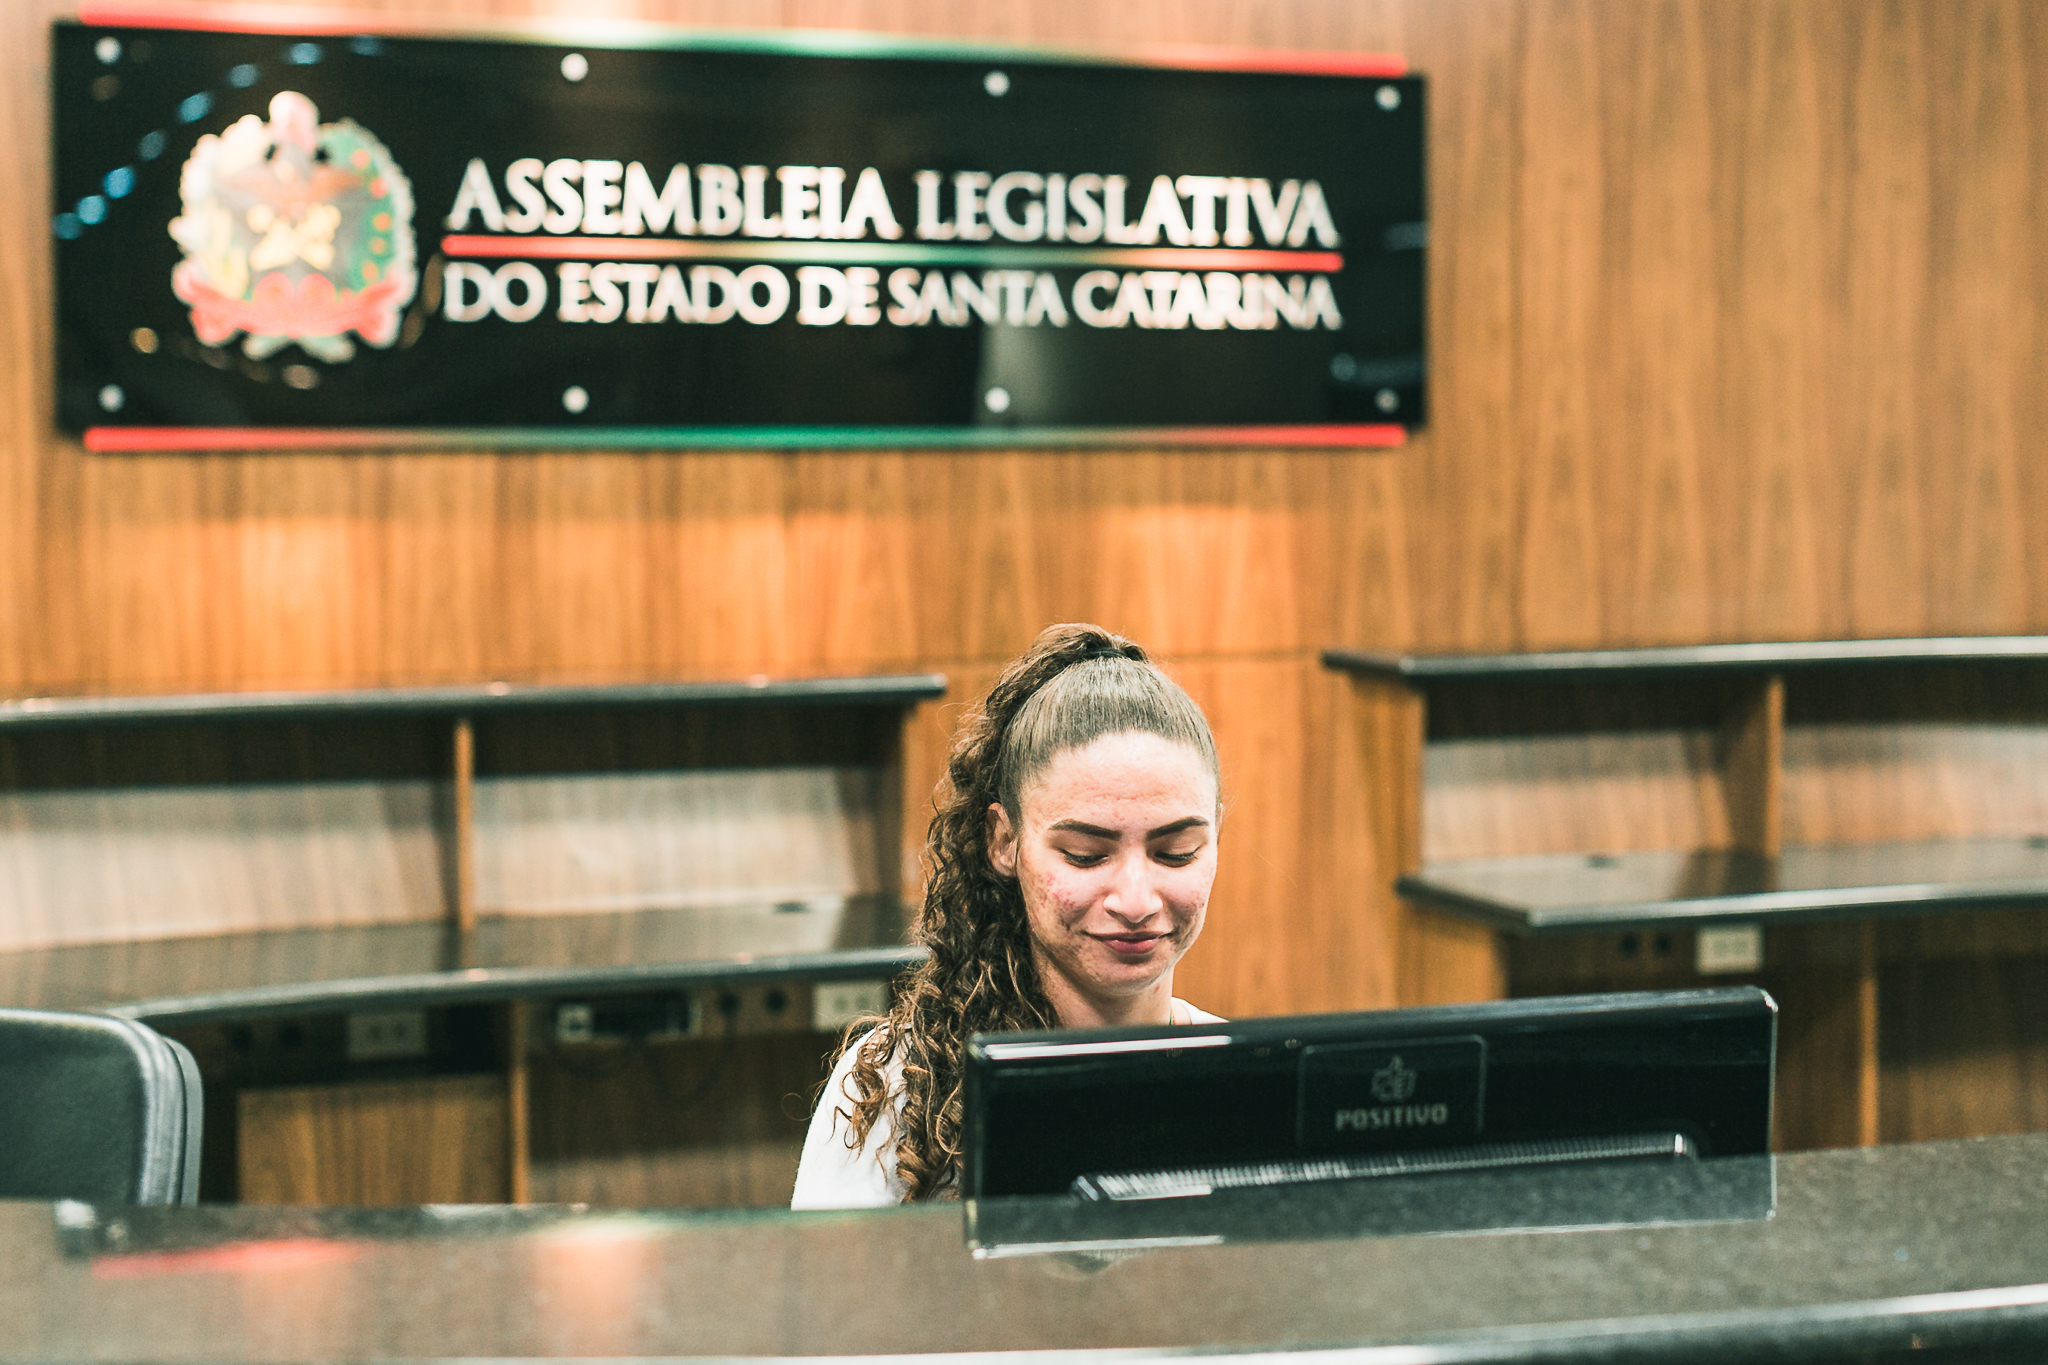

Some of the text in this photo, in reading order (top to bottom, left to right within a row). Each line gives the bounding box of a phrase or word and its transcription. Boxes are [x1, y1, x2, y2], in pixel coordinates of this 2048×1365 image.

[446, 156, 1341, 249] ASSEMBLEIA LEGISLATIVA
[442, 261, 1343, 331] DO ESTADO DE SANTA CATARINA
[1335, 1103, 1449, 1131] POSITIVO
